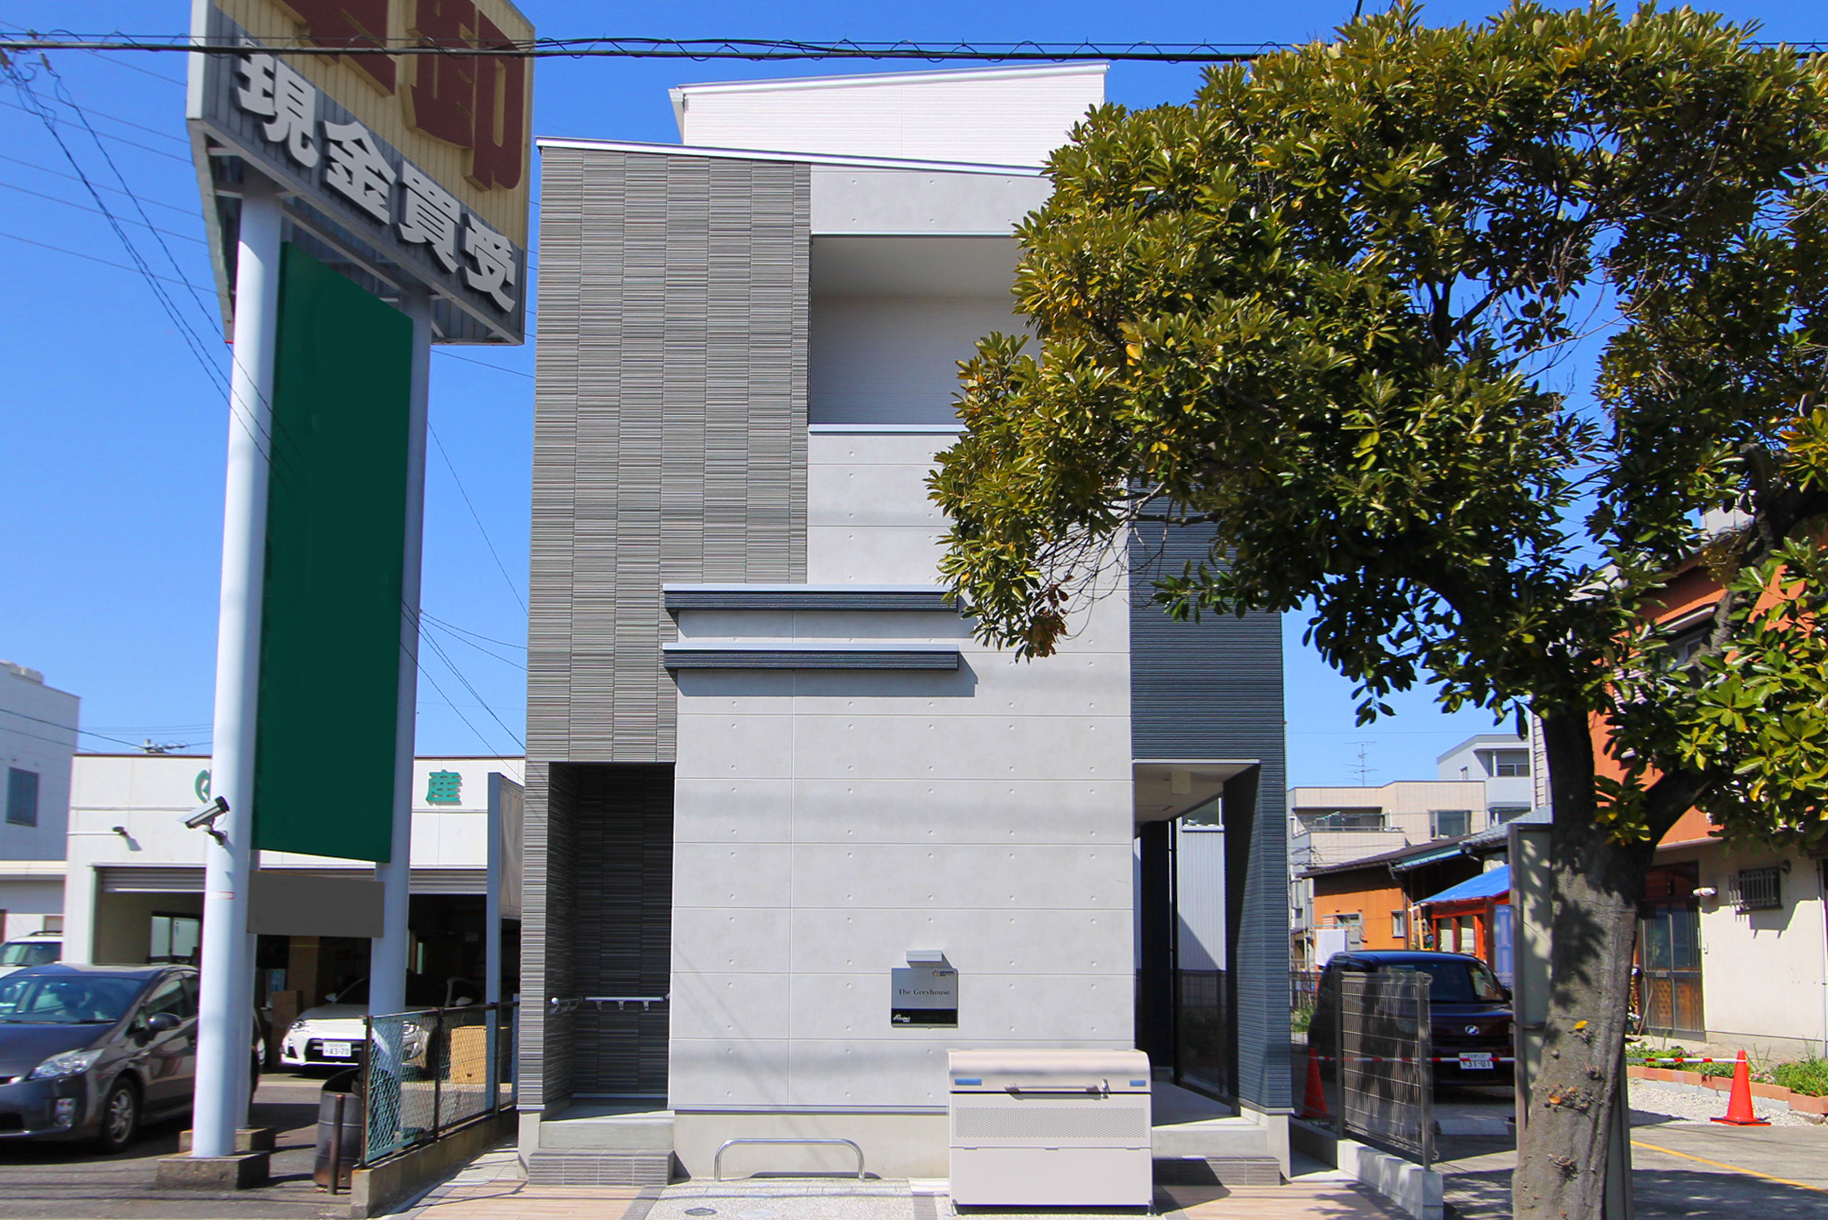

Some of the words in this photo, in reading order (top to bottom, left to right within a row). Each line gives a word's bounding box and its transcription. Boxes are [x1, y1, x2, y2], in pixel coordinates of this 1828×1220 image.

[235, 34, 516, 313] 現金買受
[426, 769, 461, 804] 産
[898, 988, 912, 996] The
[913, 988, 951, 997] Greyhouse
